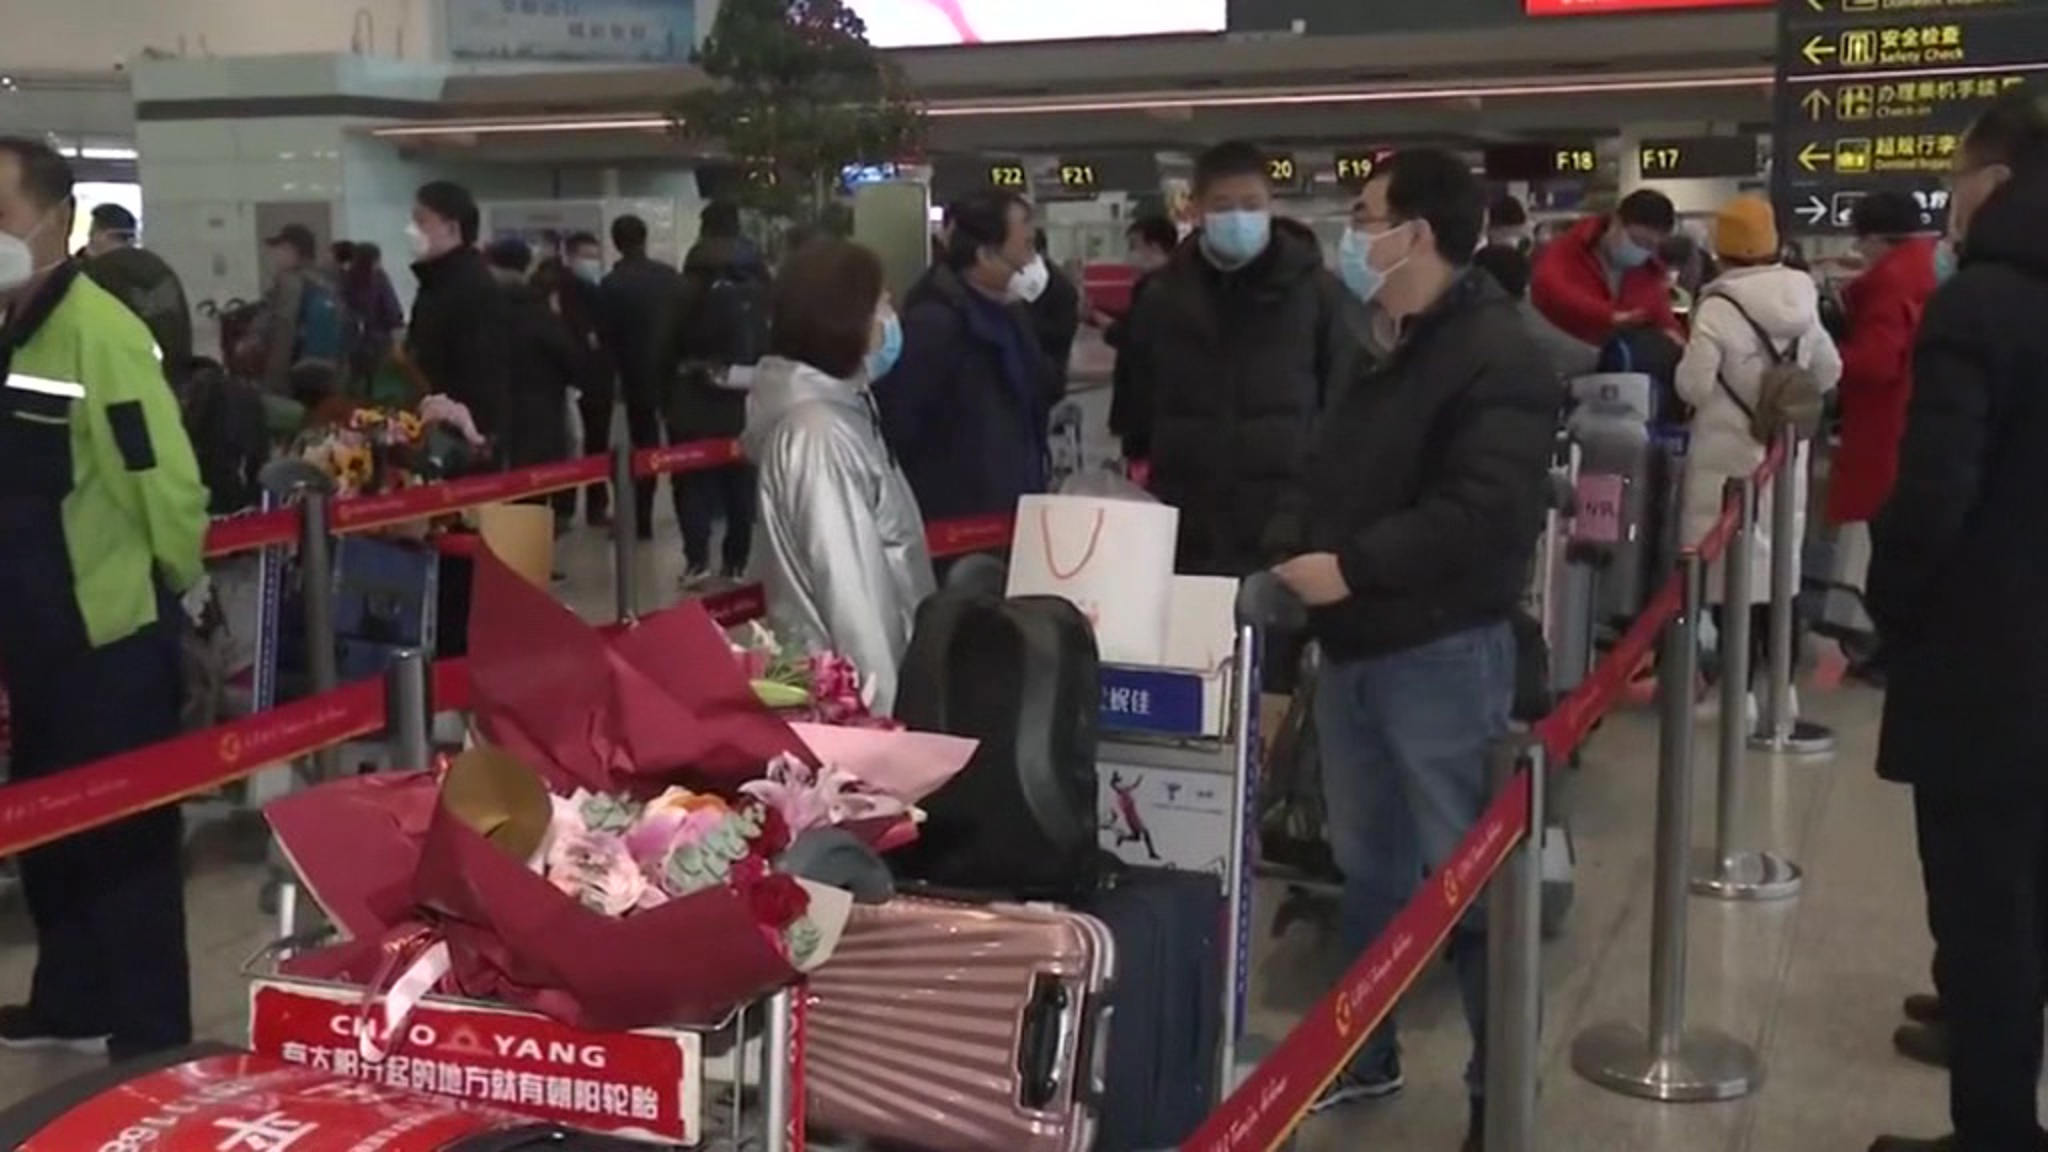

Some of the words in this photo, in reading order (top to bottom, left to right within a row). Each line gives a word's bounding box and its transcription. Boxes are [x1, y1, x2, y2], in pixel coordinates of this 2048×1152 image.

[1880, 26, 1960, 49] 安全检查
[1924, 47, 1965, 62] Check
[1338, 159, 1372, 178] F19
[1556, 151, 1594, 171] F18
[1643, 149, 1679, 169] F17
[992, 167, 1022, 185] F22
[1061, 166, 1094, 185] F21
[1267, 160, 1293, 178] 20
[330, 1015, 436, 1046] CHO
[494, 1034, 606, 1067] YANG
